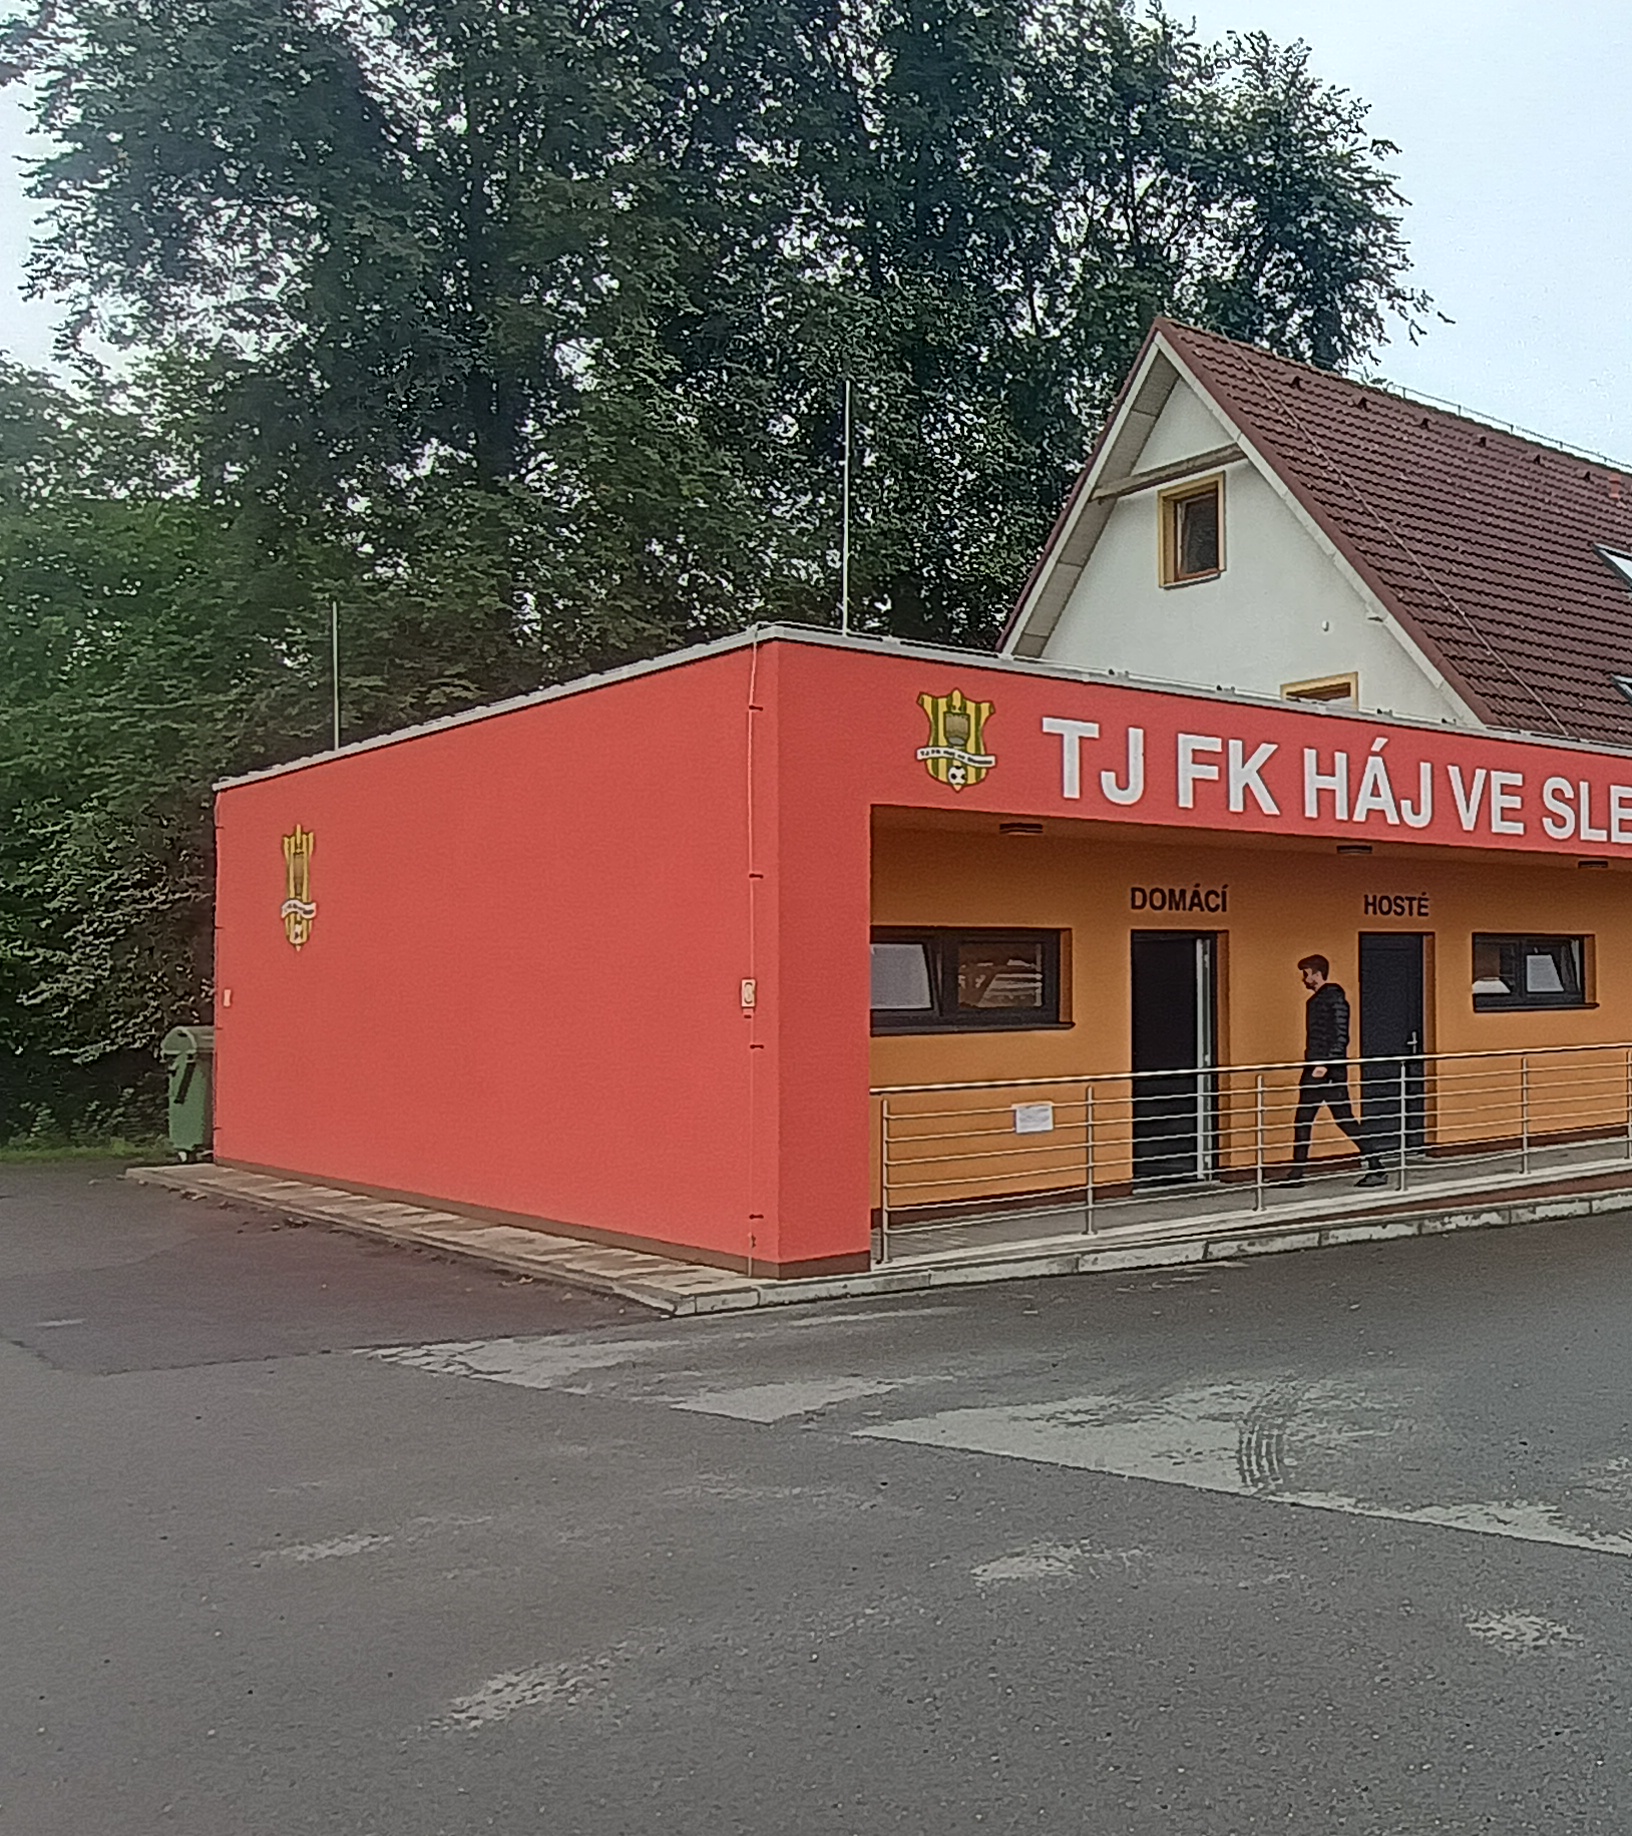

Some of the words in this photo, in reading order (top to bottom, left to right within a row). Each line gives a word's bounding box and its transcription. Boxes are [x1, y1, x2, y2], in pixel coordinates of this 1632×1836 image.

[1042, 717, 1145, 805] TJ
[1177, 733, 1280, 815] FK
[1303, 737, 1433, 828] HÁJ
[1447, 765, 1525, 835] VE
[1130, 883, 1229, 912] DOMÁCÍ
[1363, 892, 1430, 917] HOSTÉ
